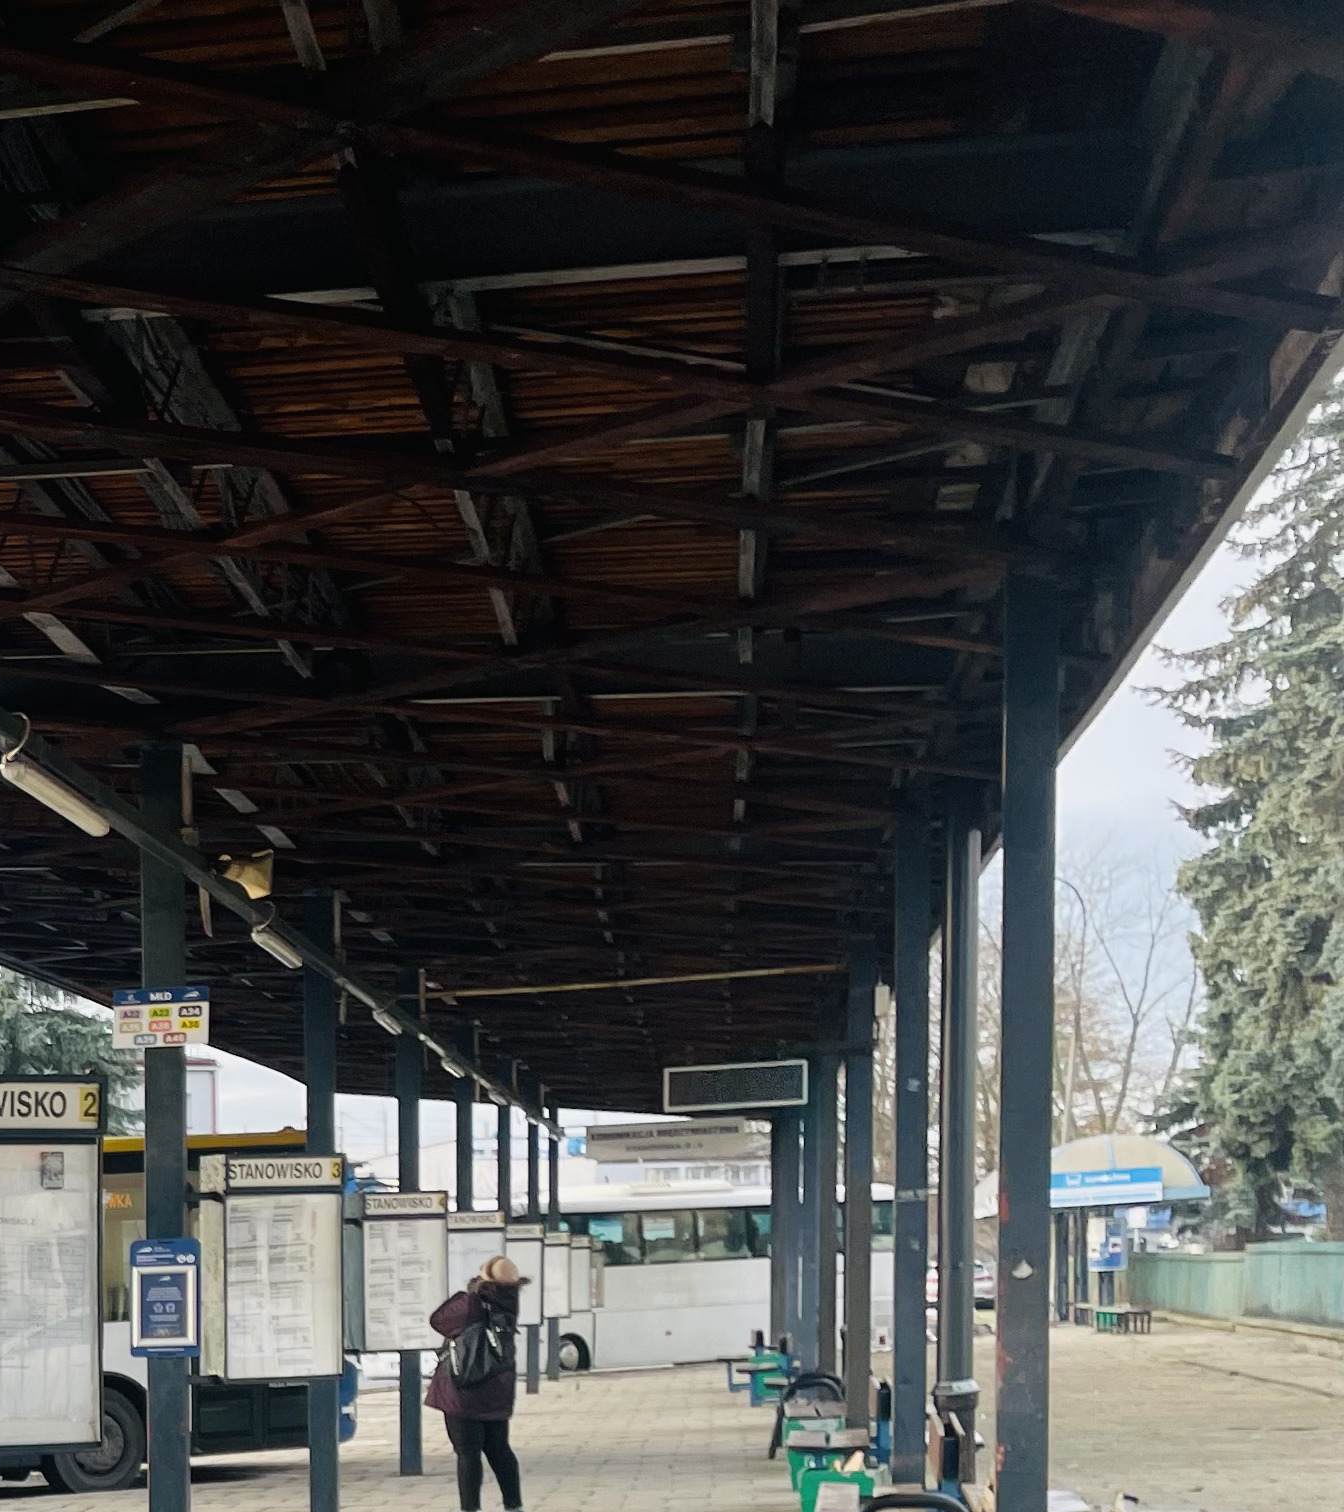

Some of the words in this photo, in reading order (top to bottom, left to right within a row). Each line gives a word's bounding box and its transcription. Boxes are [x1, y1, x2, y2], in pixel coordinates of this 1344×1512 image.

[149, 991, 172, 1001] MLD
[83, 1092, 98, 1117] 2
[228, 1163, 323, 1180] STANOWISKO
[332, 1162, 341, 1179] 3
[365, 1196, 433, 1210] STANOWISKO
